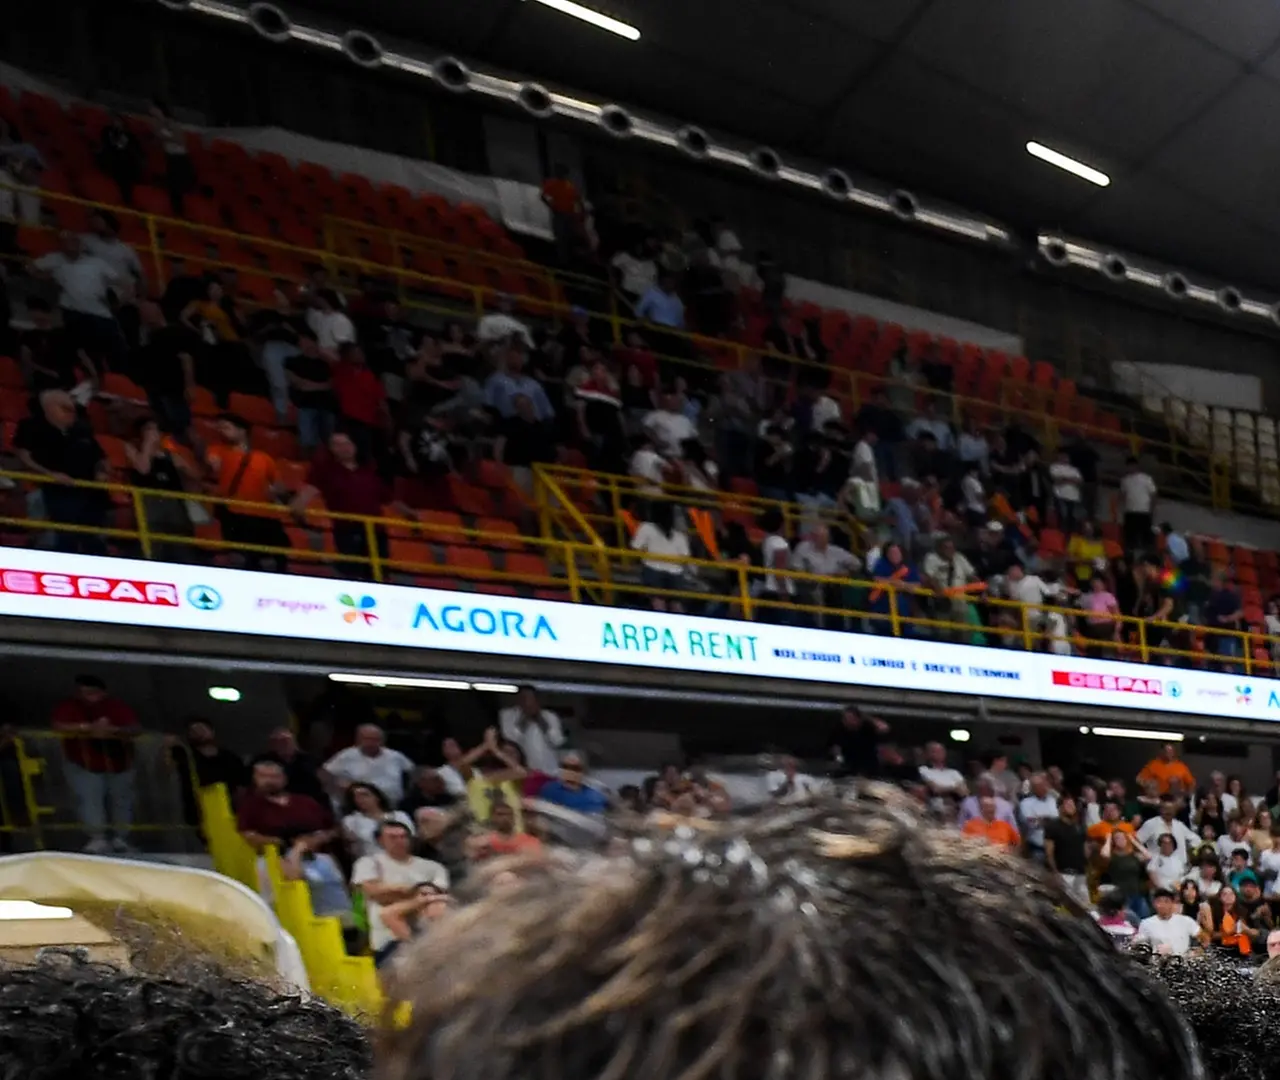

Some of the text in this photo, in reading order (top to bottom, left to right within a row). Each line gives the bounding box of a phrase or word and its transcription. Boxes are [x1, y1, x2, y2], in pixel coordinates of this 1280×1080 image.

[0, 570, 179, 606] ESPAR
[411, 603, 558, 640] AGORA
[602, 622, 758, 662] ARPA RENT
